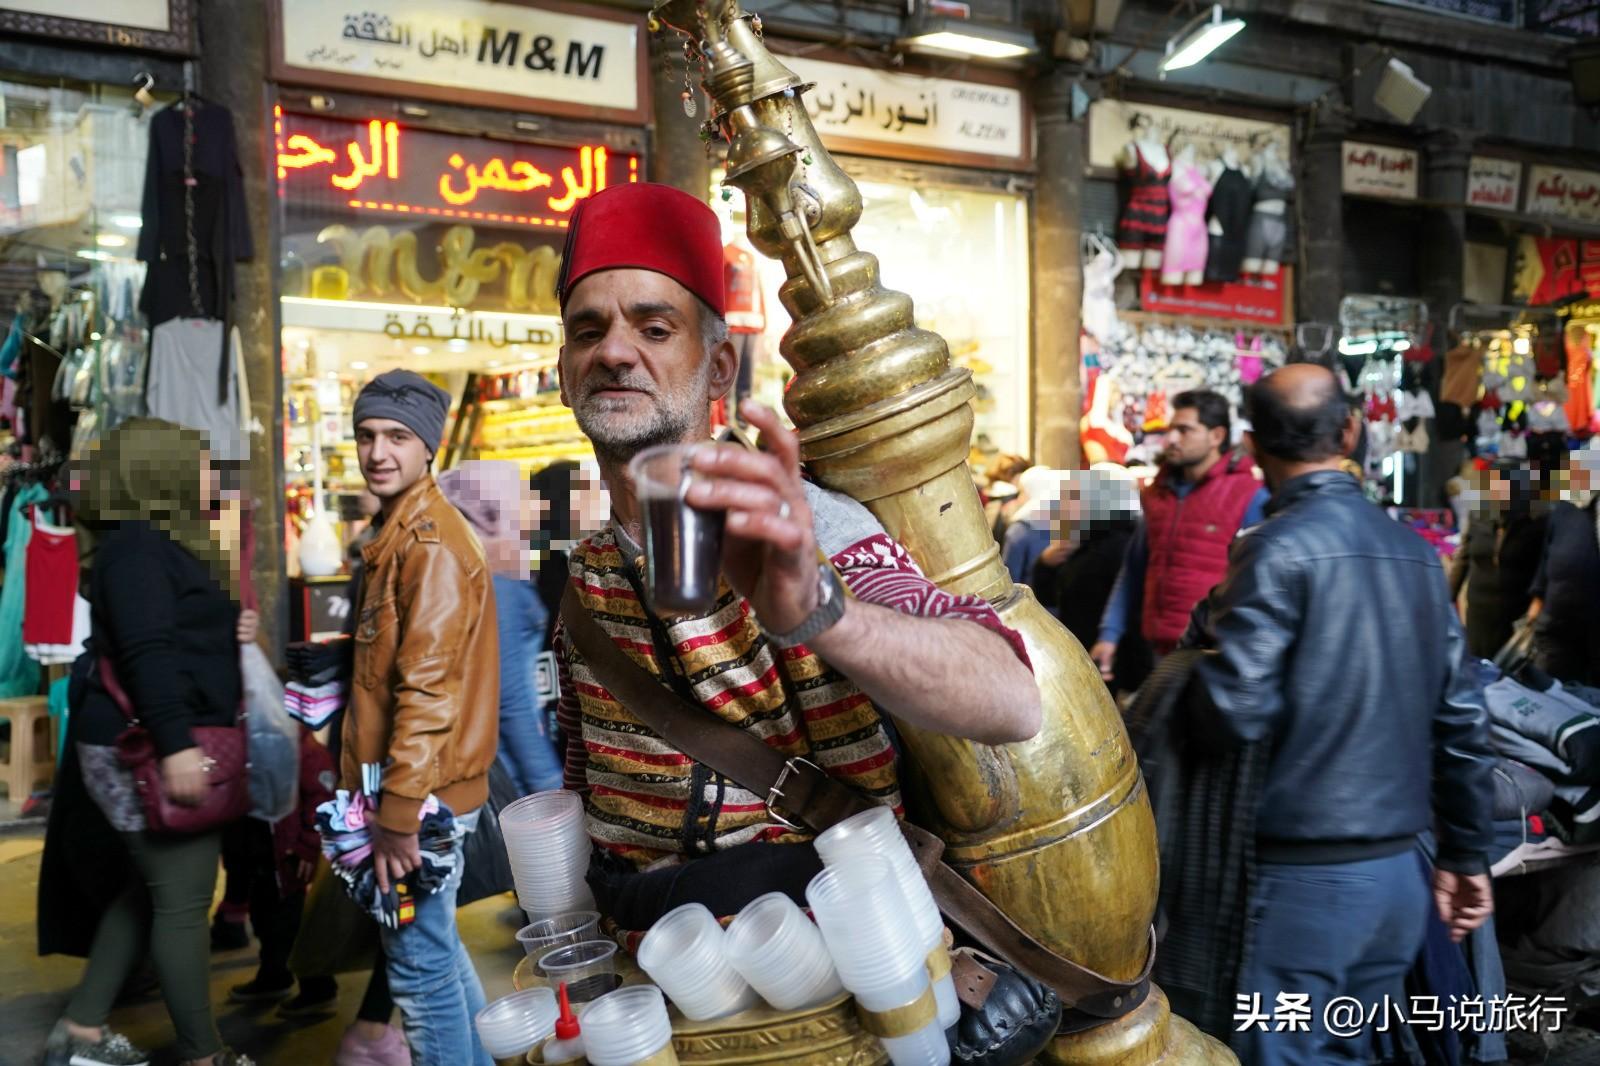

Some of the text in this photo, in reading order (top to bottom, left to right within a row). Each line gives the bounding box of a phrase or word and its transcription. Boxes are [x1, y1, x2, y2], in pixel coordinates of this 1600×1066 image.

[342, 11, 410, 45] الثقة
[475, 26, 605, 80] M&M
[439, 145, 607, 212] الرحمن
